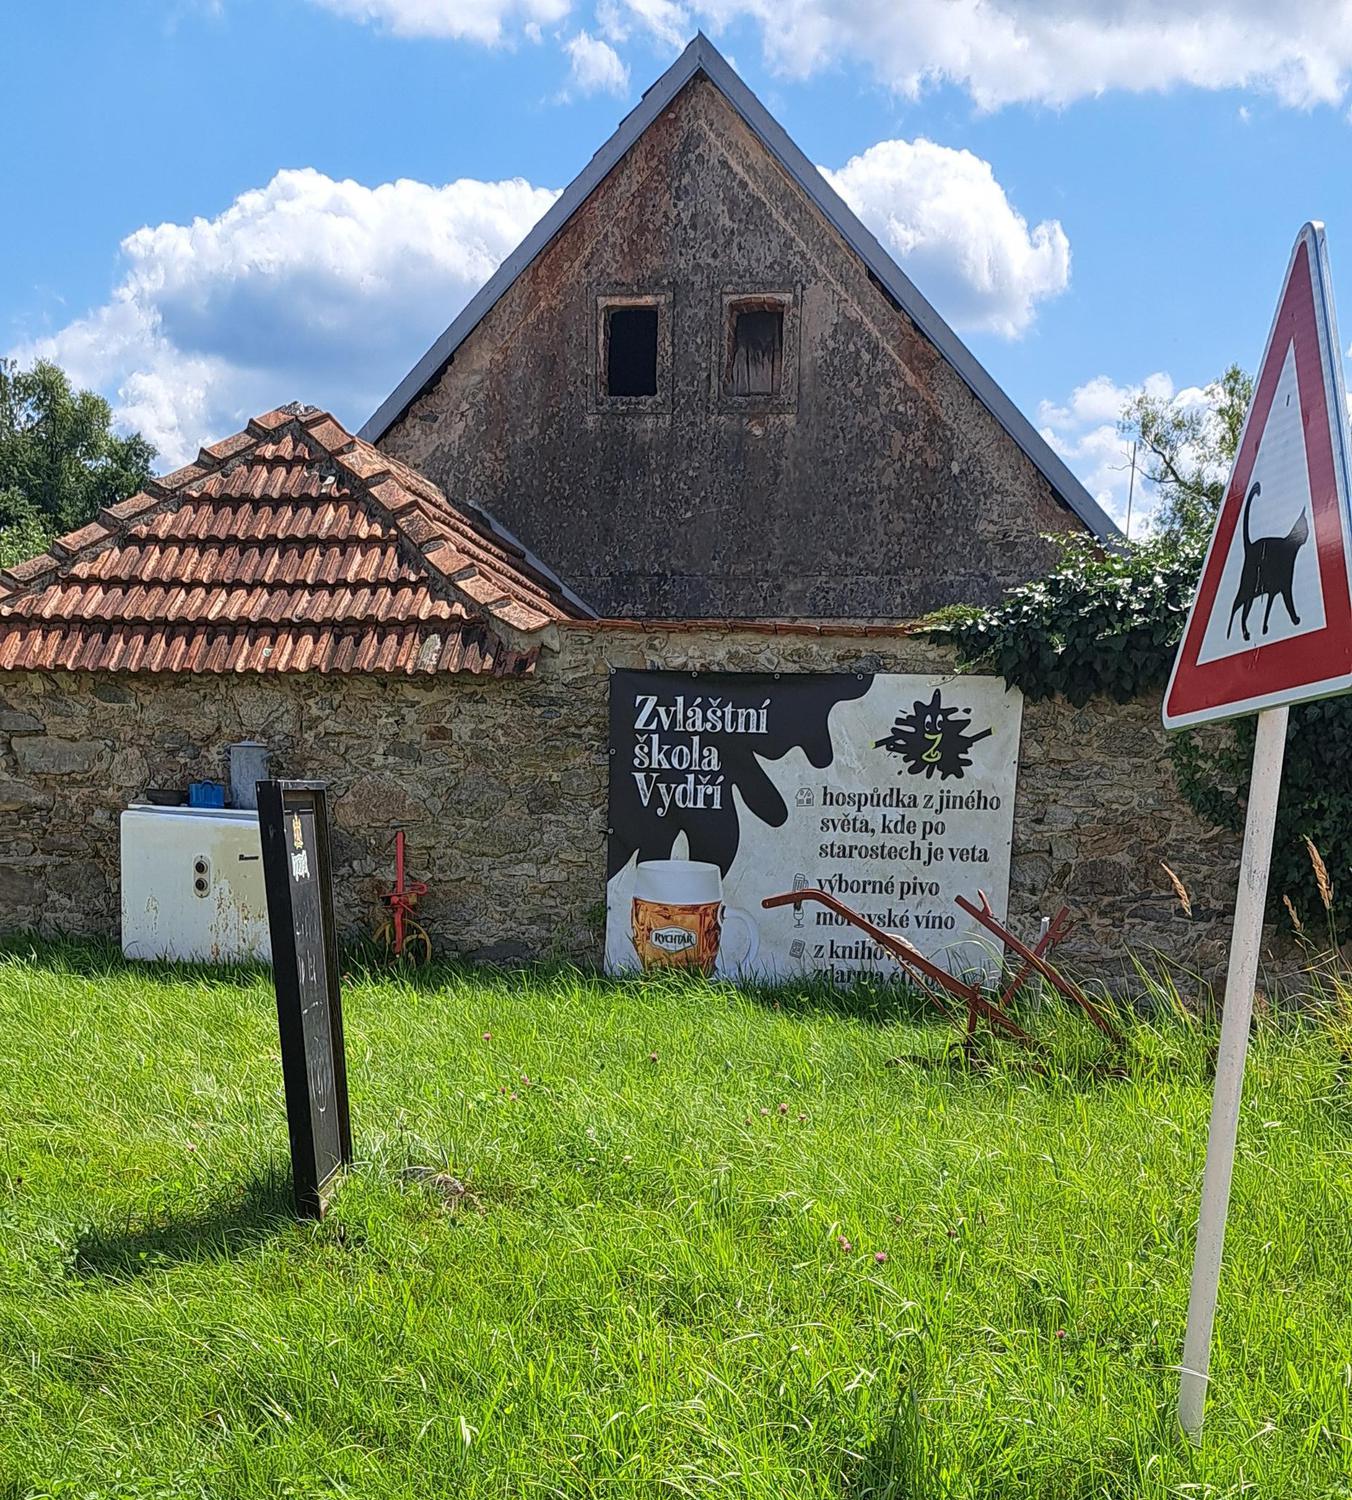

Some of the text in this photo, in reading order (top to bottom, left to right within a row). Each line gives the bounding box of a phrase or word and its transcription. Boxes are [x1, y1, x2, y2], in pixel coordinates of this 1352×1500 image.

[633, 695, 771, 733] Zvláštní
[633, 733, 721, 771] škola
[631, 772, 725, 817] Vydří
[821, 785, 1001, 815] hospůdka z jiného
[819, 813, 946, 840] světa, kde po
[818, 840, 990, 867] starostech je veta
[816, 873, 940, 900] výborné pivo
[816, 908, 955, 930] movské víno
[814, 944, 824, 959] z
